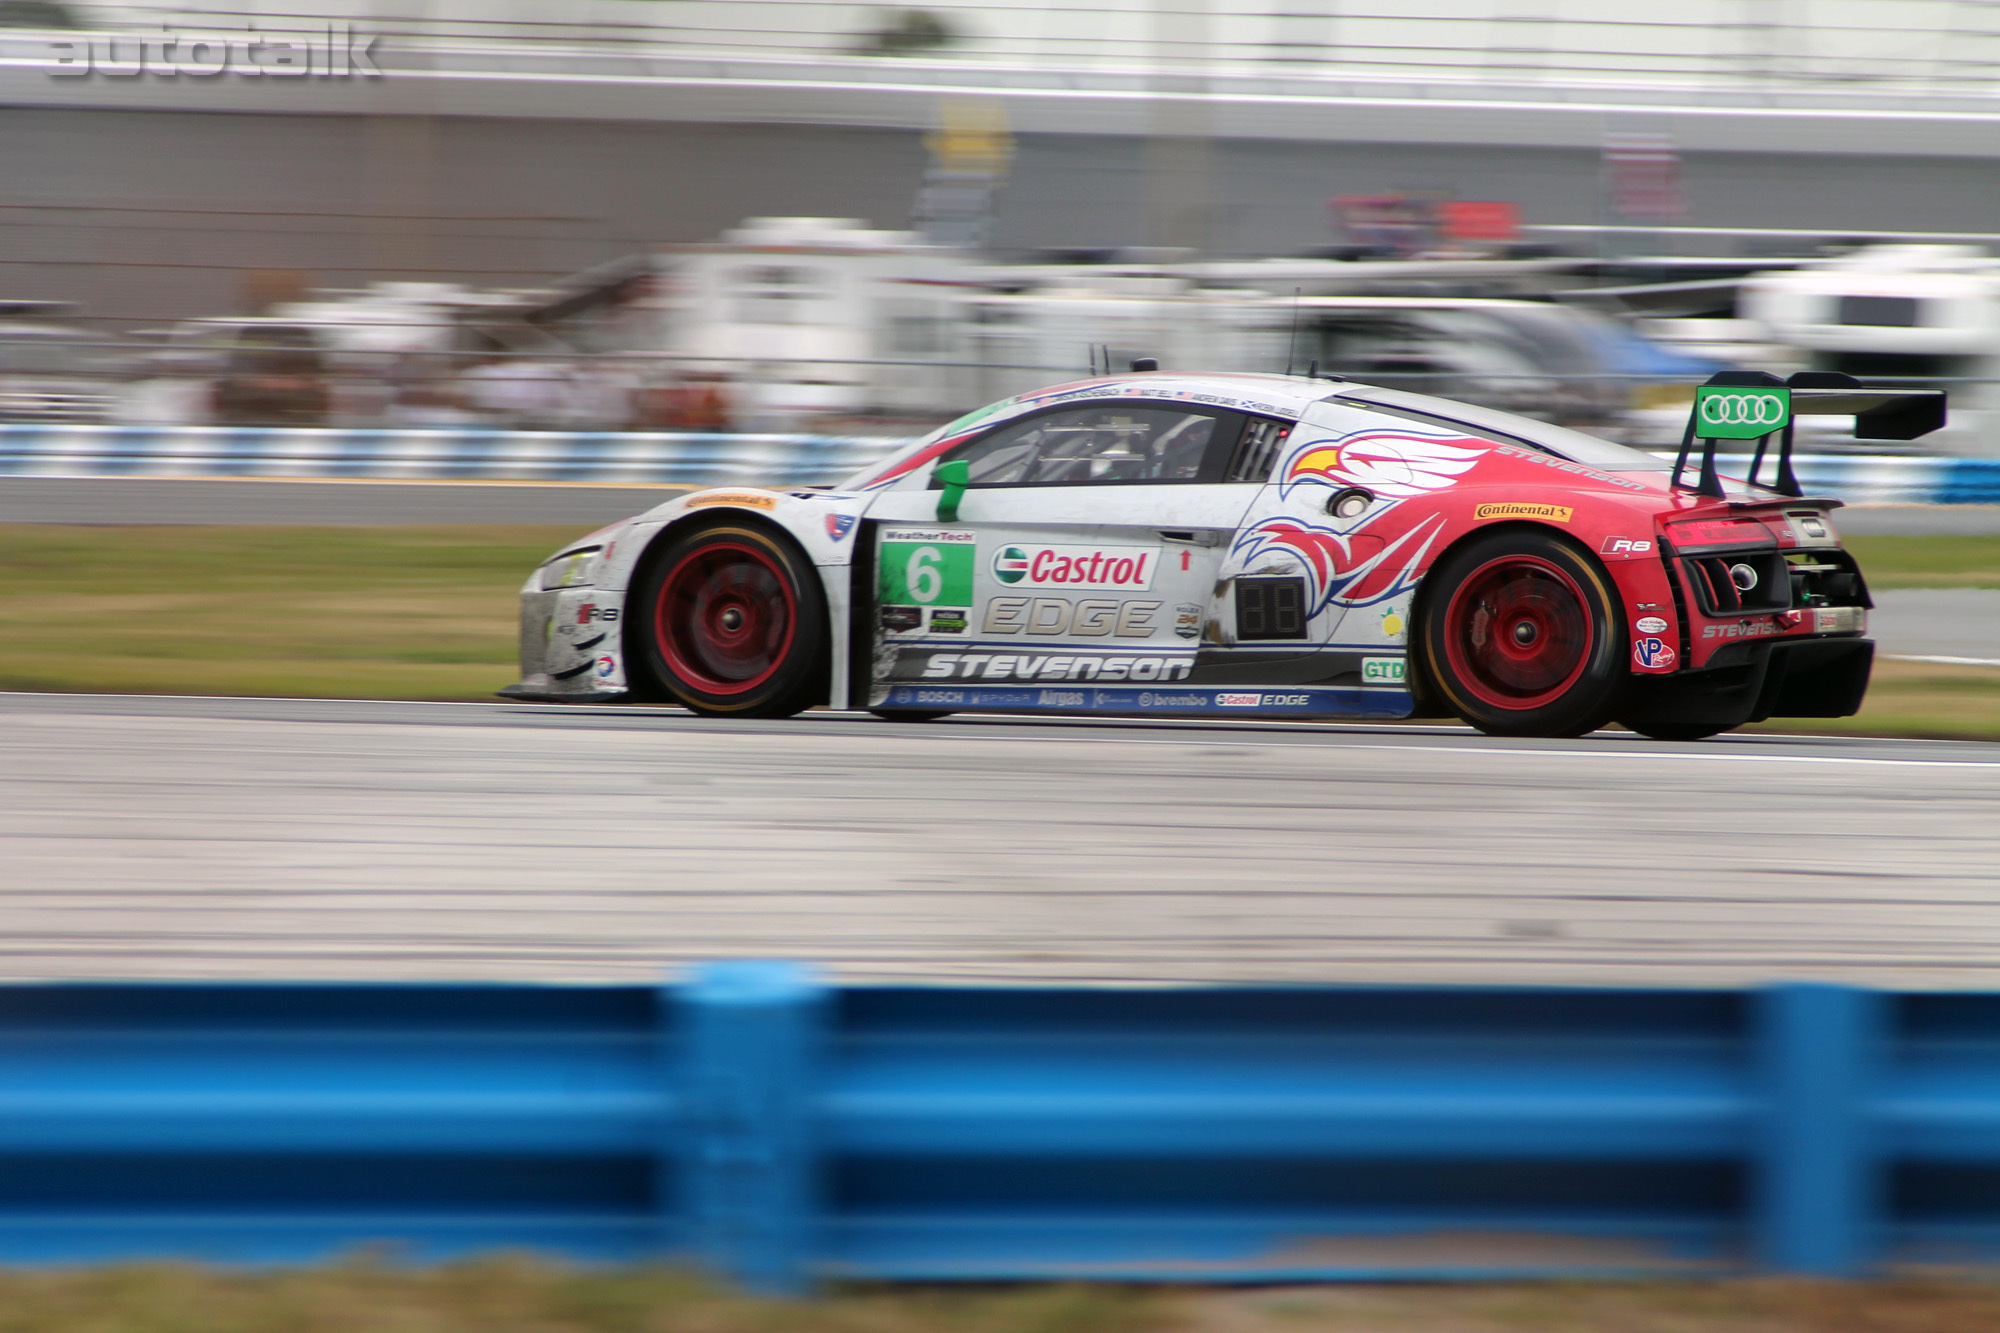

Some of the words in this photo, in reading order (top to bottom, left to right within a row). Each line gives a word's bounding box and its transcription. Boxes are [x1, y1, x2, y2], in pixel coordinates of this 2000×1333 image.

[1494, 445, 1647, 491] STEVENSON
[1477, 504, 1555, 518] Continental
[886, 532, 973, 542] WeatherTech
[1612, 540, 1652, 552] R8
[906, 546, 943, 603] 6
[1031, 549, 1148, 585] Castrol
[981, 596, 1164, 638] EDGE
[1635, 638, 1663, 667] VP
[921, 653, 1195, 681] STEVENSON
[1365, 661, 1405, 679] GTD
[917, 690, 963, 703] BOSCH
[1038, 689, 1084, 706] Airgas
[1154, 693, 1208, 706] brembo
[1262, 694, 1310, 706] EDGE
